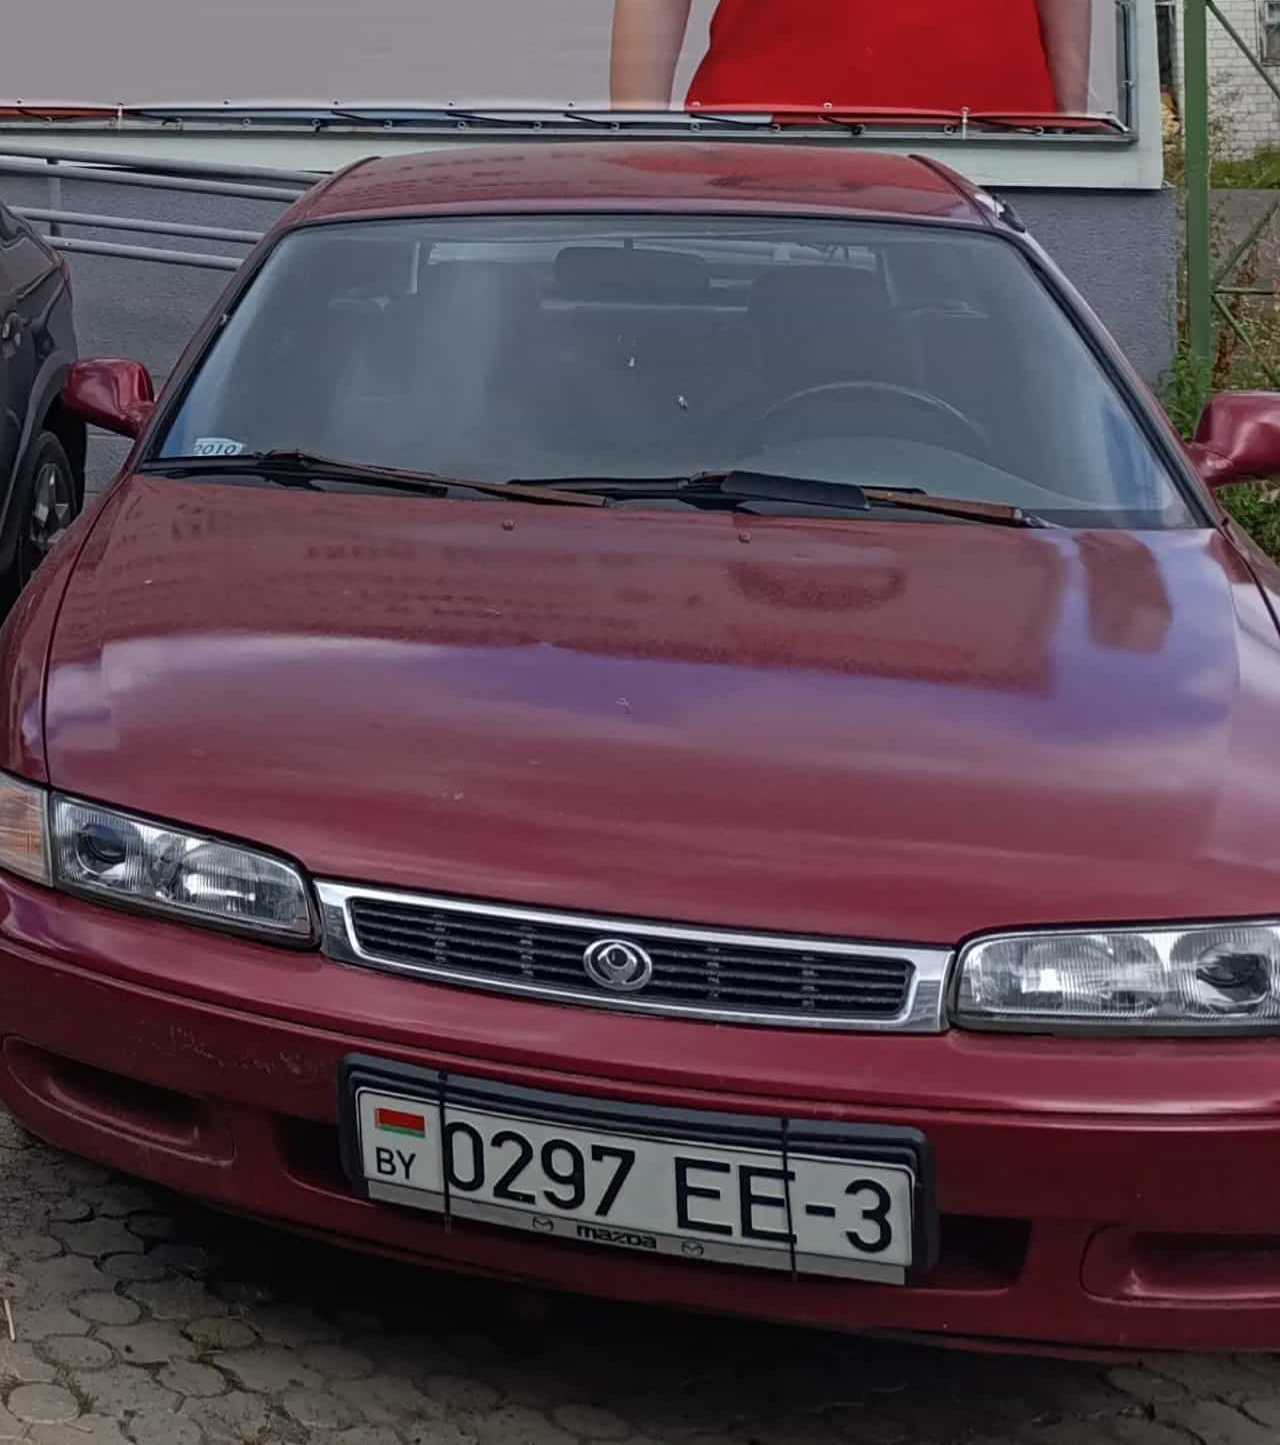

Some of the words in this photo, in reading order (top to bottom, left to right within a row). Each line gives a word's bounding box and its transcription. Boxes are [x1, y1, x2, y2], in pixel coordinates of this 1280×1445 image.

[375, 1147, 416, 1180] BY
[442, 1120, 636, 1217] 0297
[674, 1156, 892, 1254] EE-3
[576, 1224, 657, 1251] mazda
